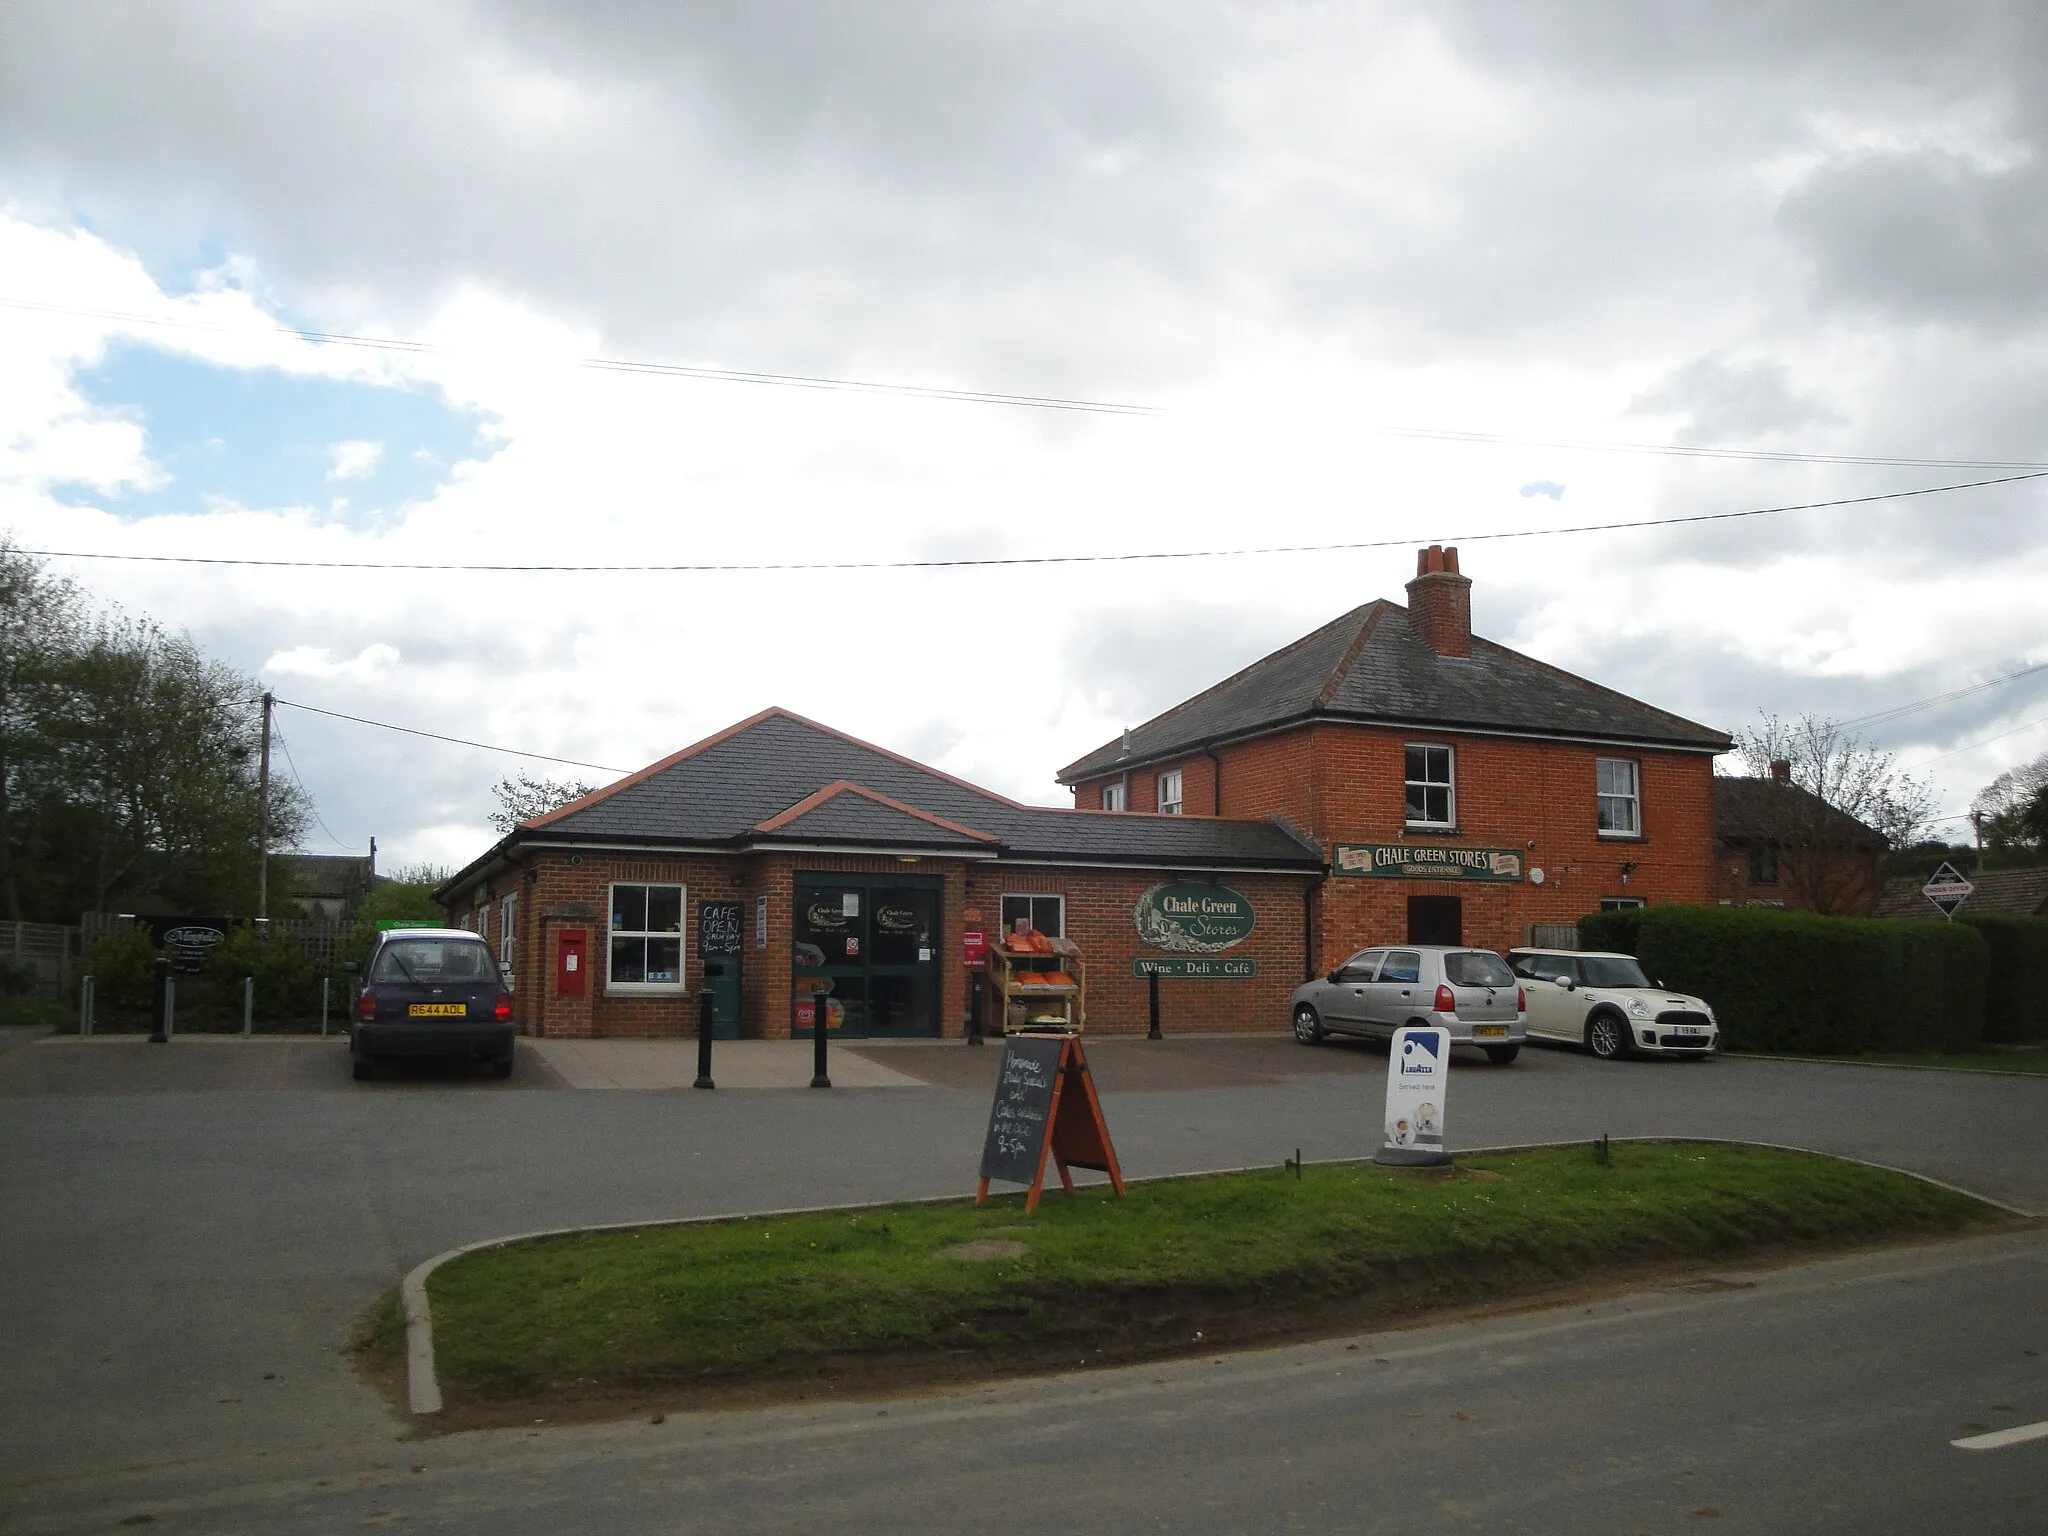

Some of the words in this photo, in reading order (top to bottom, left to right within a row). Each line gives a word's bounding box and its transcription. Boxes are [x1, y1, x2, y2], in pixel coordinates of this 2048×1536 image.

[1375, 848, 1410, 867] CHALE
[1414, 849, 1446, 863] GREEN
[1449, 851, 1488, 870] STORES
[1406, 865, 1427, 873] GOODS
[1163, 896, 1199, 913] Chale
[1202, 897, 1237, 914] Green
[704, 906, 738, 920] CAFE
[702, 920, 740, 934] OPEN
[1190, 915, 1238, 936] Stores
[1141, 962, 1172, 974] Wine
[1186, 962, 1210, 973] Deli
[1224, 962, 1250, 973] Café
[411, 1006, 440, 1015] R644
[1405, 1064, 1433, 1074] LAVAZZA
